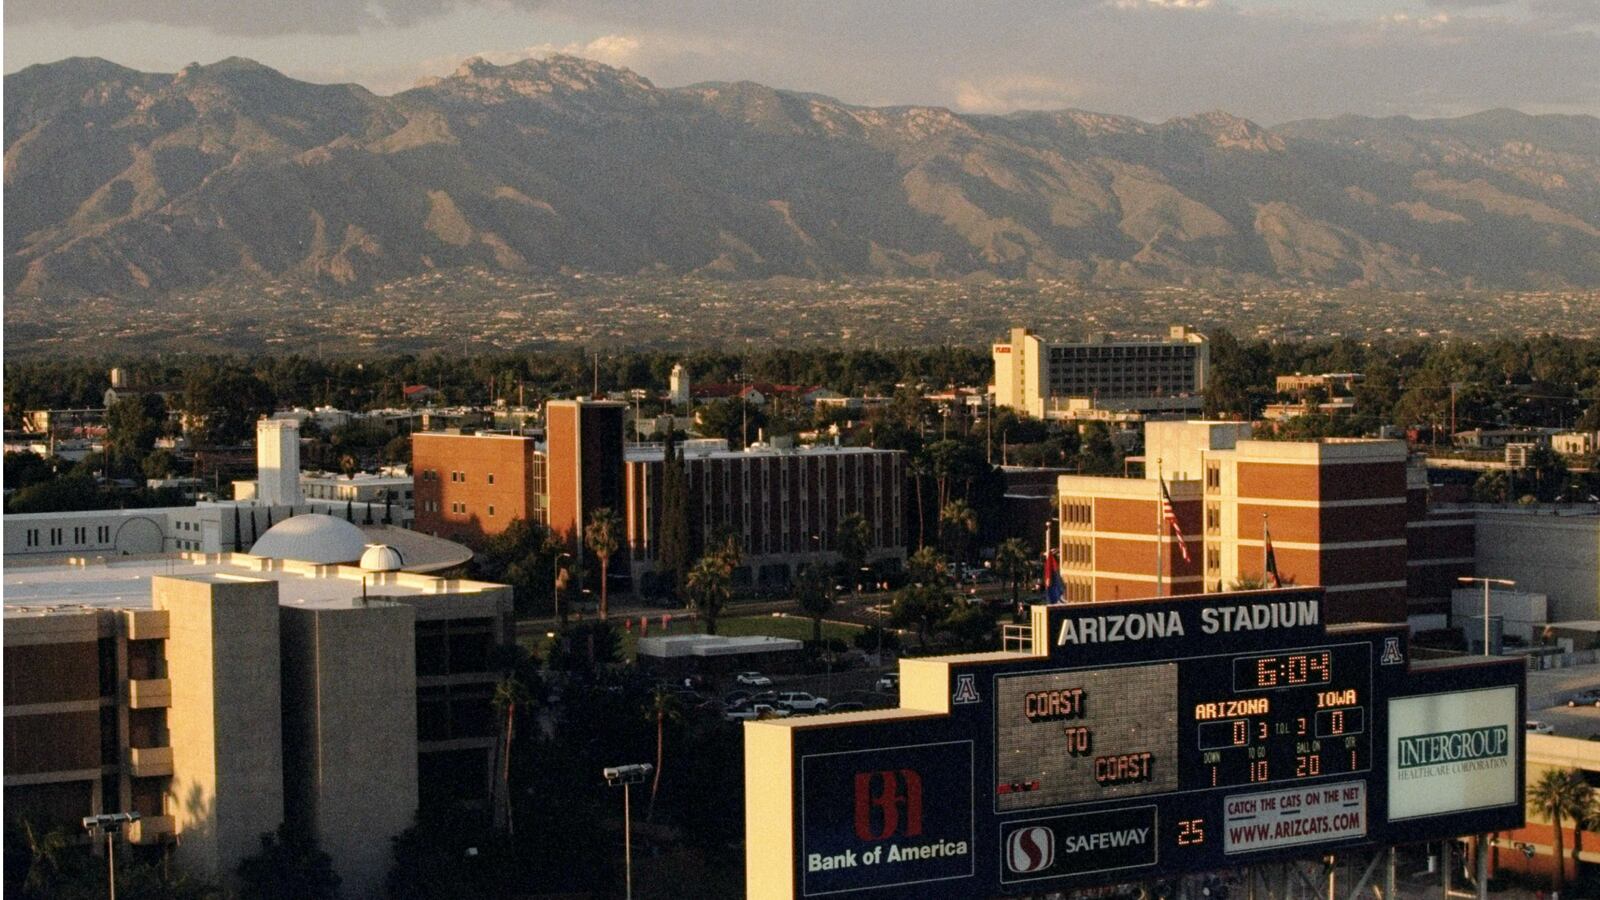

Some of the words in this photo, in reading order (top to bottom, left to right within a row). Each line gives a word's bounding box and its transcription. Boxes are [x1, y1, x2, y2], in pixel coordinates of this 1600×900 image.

[1057, 611, 1185, 646] ARIZONA
[1201, 600, 1319, 634] STADIUM
[1381, 637, 1403, 665] A
[1258, 653, 1329, 686] 6:04
[953, 674, 980, 704] A
[1317, 689, 1357, 707] IOWA
[1025, 688, 1084, 719] COAST
[1195, 698, 1269, 720] ARIZONA
[1233, 721, 1245, 744] 0
[1258, 722, 1267, 738] 3
[1332, 711, 1343, 734] 0
[1065, 727, 1087, 752] TO
[1297, 741, 1311, 753] BALL
[1312, 740, 1321, 751] ON
[1400, 728, 1507, 766] INTERGROUP
[1203, 752, 1221, 764] DOWN
[1249, 748, 1256, 759] TO
[1257, 746, 1266, 758] GO
[1351, 750, 1356, 770] 1
[1095, 752, 1151, 782] COAST
[1212, 766, 1217, 786] 1
[1250, 761, 1267, 782] 10
[1297, 755, 1319, 776] 20
[1399, 766, 1450, 781] HEALTHCARE
[1451, 757, 1508, 774] CORPORATION
[1228, 801, 1256, 815] CATCH
[1260, 797, 1276, 811] THE
[1280, 795, 1301, 809] CATS
[1306, 792, 1320, 806] ON
[1324, 788, 1339, 802] THE
[1343, 787, 1360, 800] NET
[1066, 827, 1150, 853] SAFEWAY
[1178, 819, 1204, 845] 25
[1230, 812, 1360, 845] WWW.ARIZCATS.COM
[808, 850, 857, 872] Bank
[862, 846, 882, 865] of
[887, 839, 968, 863] America
